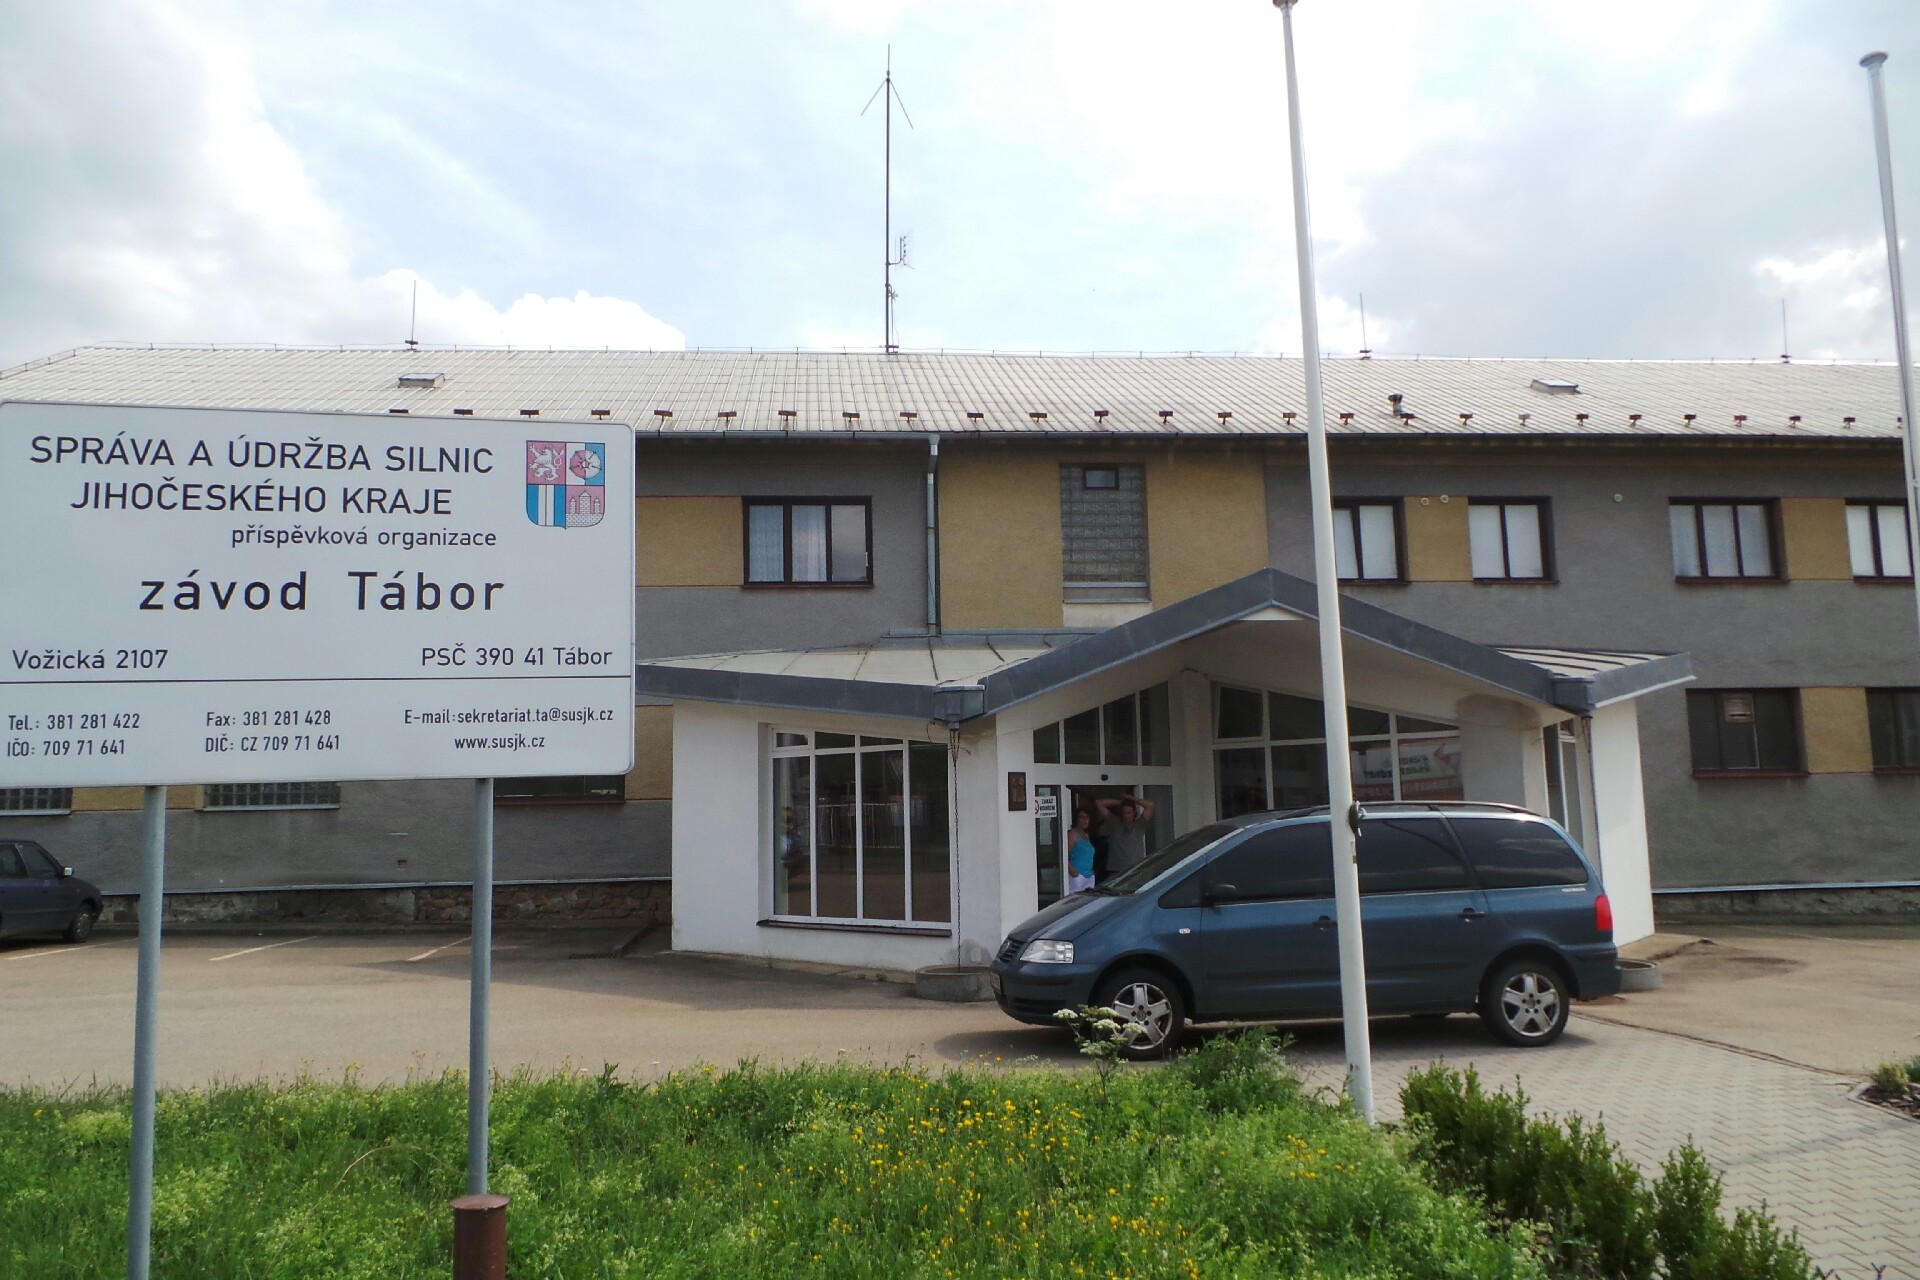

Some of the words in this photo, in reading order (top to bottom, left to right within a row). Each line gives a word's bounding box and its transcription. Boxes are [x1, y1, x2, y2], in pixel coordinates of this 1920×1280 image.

[30, 431, 175, 465] SPRÁVA
[188, 440, 213, 467] A
[228, 435, 371, 470] ÚDRŽBA
[385, 446, 493, 473] SILNIC
[70, 477, 326, 513] JIHOČESKÉHO
[343, 487, 452, 515] KRAJE
[232, 524, 367, 548] příspěvková
[378, 528, 496, 550] organizace
[139, 569, 307, 610] závod
[348, 571, 504, 610] Tábor
[12, 649, 105, 669] Vožická
[116, 649, 168, 668] 2107
[422, 643, 466, 666] PSČ
[476, 648, 513, 665] 390
[524, 647, 543, 665] 41
[553, 647, 613, 665] Tábor
[8, 715, 39, 730] Tel.:
[47, 715, 73, 730] 381
[80, 714, 106, 729] 281
[113, 713, 140, 728] 422
[206, 712, 235, 726] Fax:
[243, 711, 267, 726] 381
[274, 711, 298, 725] 281
[305, 710, 330, 725] 428
[7, 738, 35, 757] IČO:
[43, 740, 70, 756] 709
[77, 740, 92, 755] 71
[100, 739, 124, 755] 641
[205, 733, 233, 752] DIČ:
[241, 737, 258, 751] CZ
[263, 736, 288, 751] 709
[295, 736, 309, 750] 71
[317, 735, 339, 750] 641
[454, 733, 545, 752] www.susjk.cz
